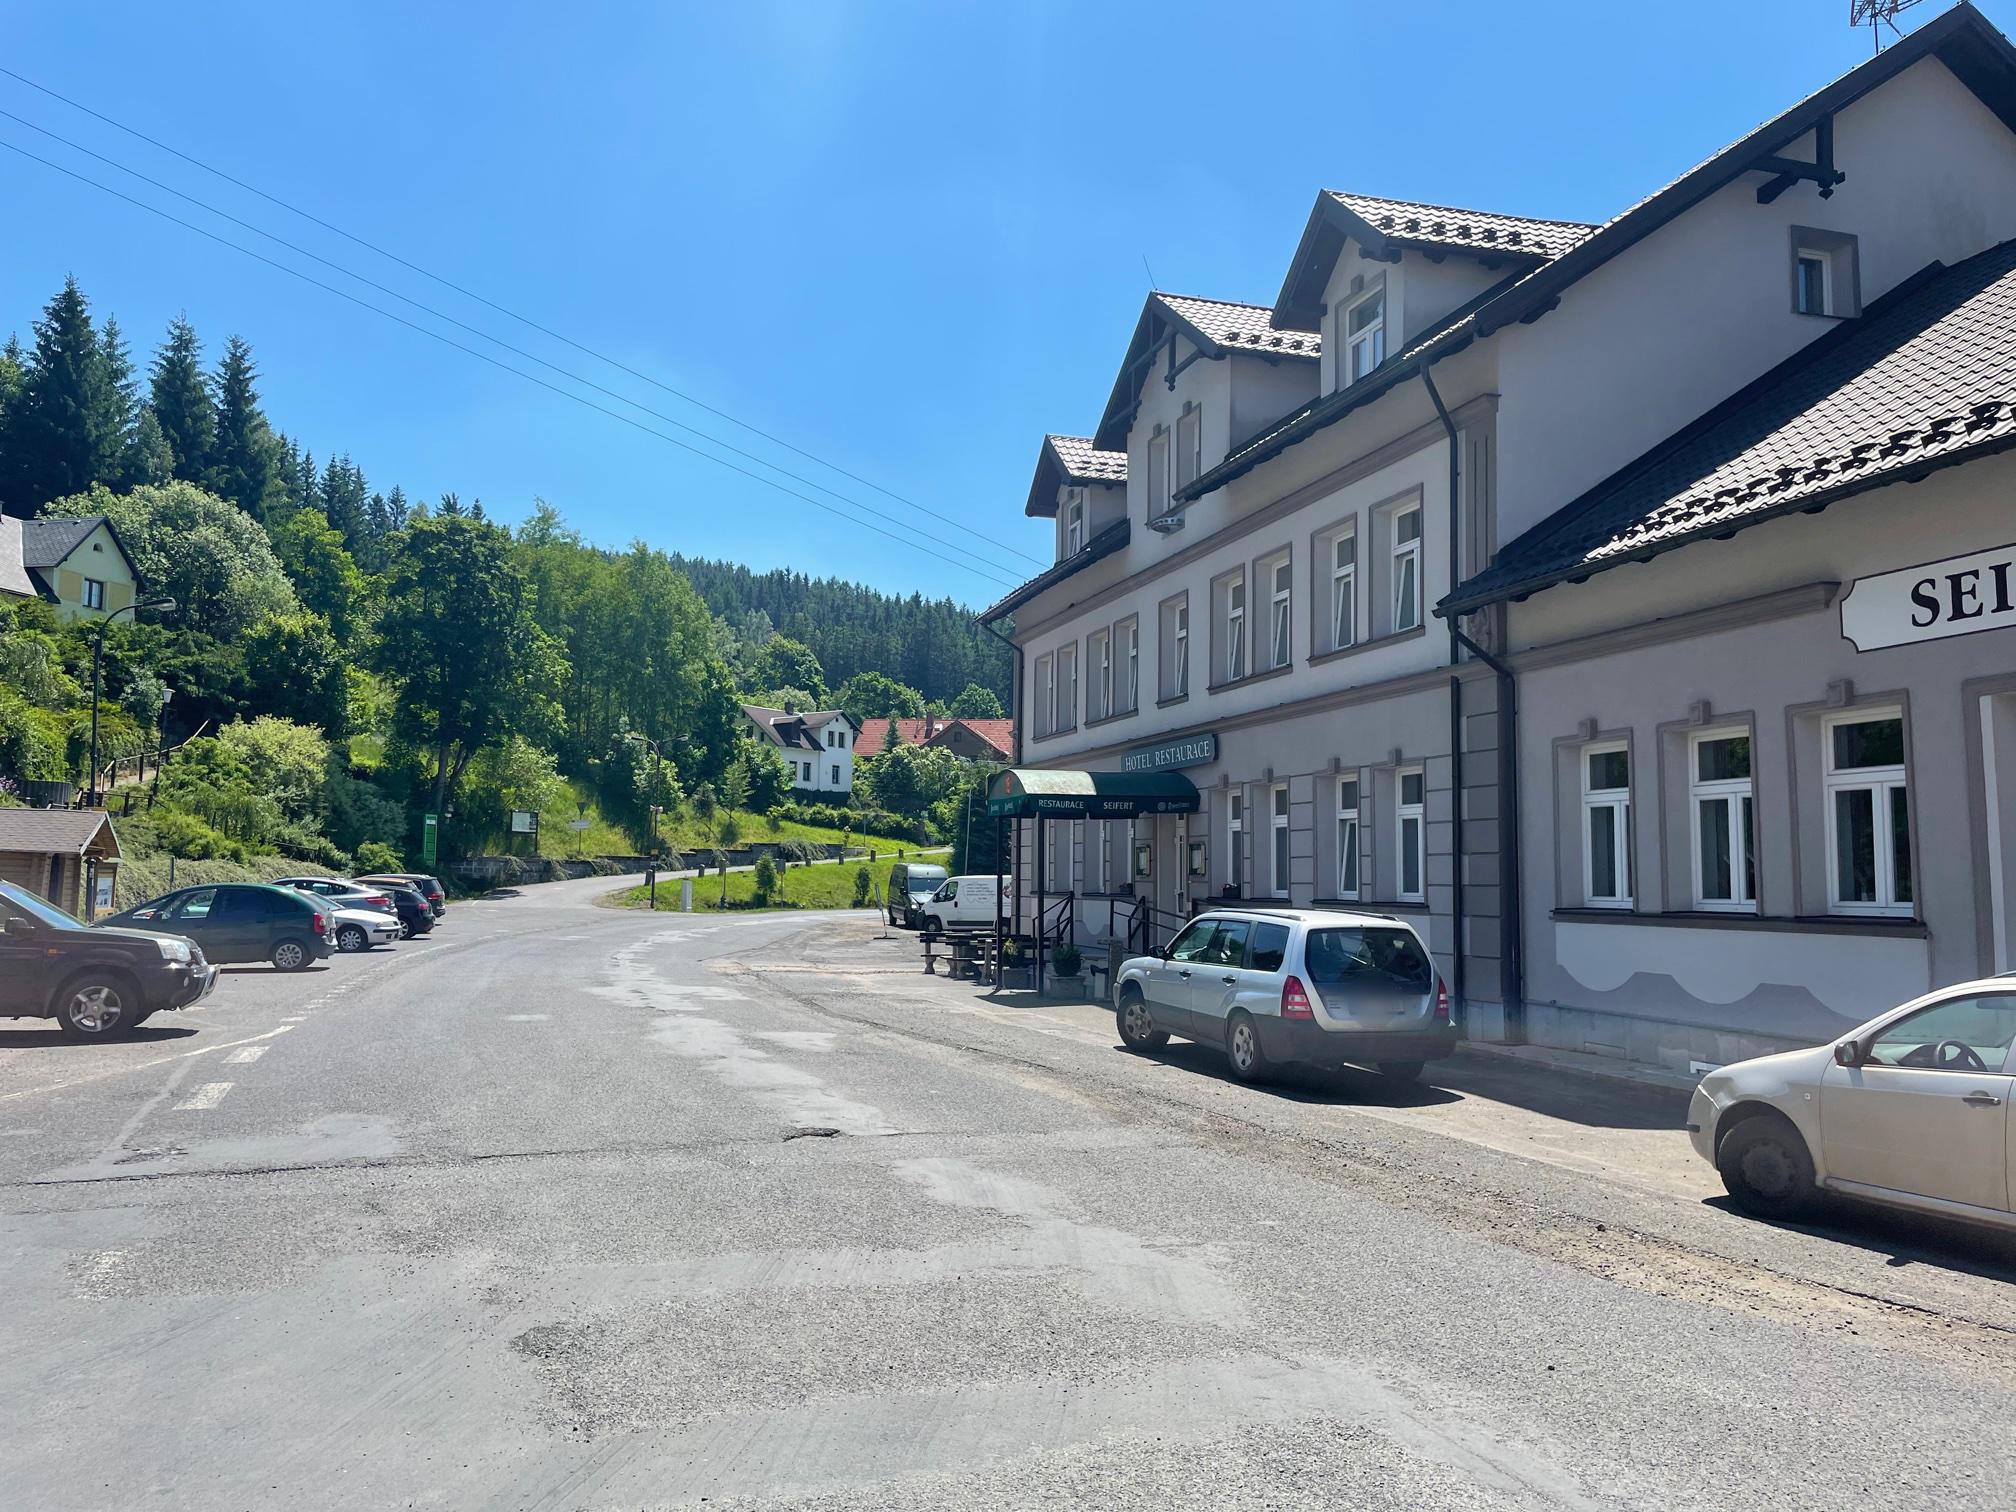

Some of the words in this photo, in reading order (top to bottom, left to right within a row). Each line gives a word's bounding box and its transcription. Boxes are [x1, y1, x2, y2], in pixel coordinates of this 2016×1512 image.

[1911, 562, 2015, 627] SEI
[1125, 753, 1152, 771] HOTEL
[1155, 740, 1210, 766] RESTAURACE
[1038, 799, 1084, 809] RESTAURACE
[1103, 801, 1134, 810] SEIFERT
